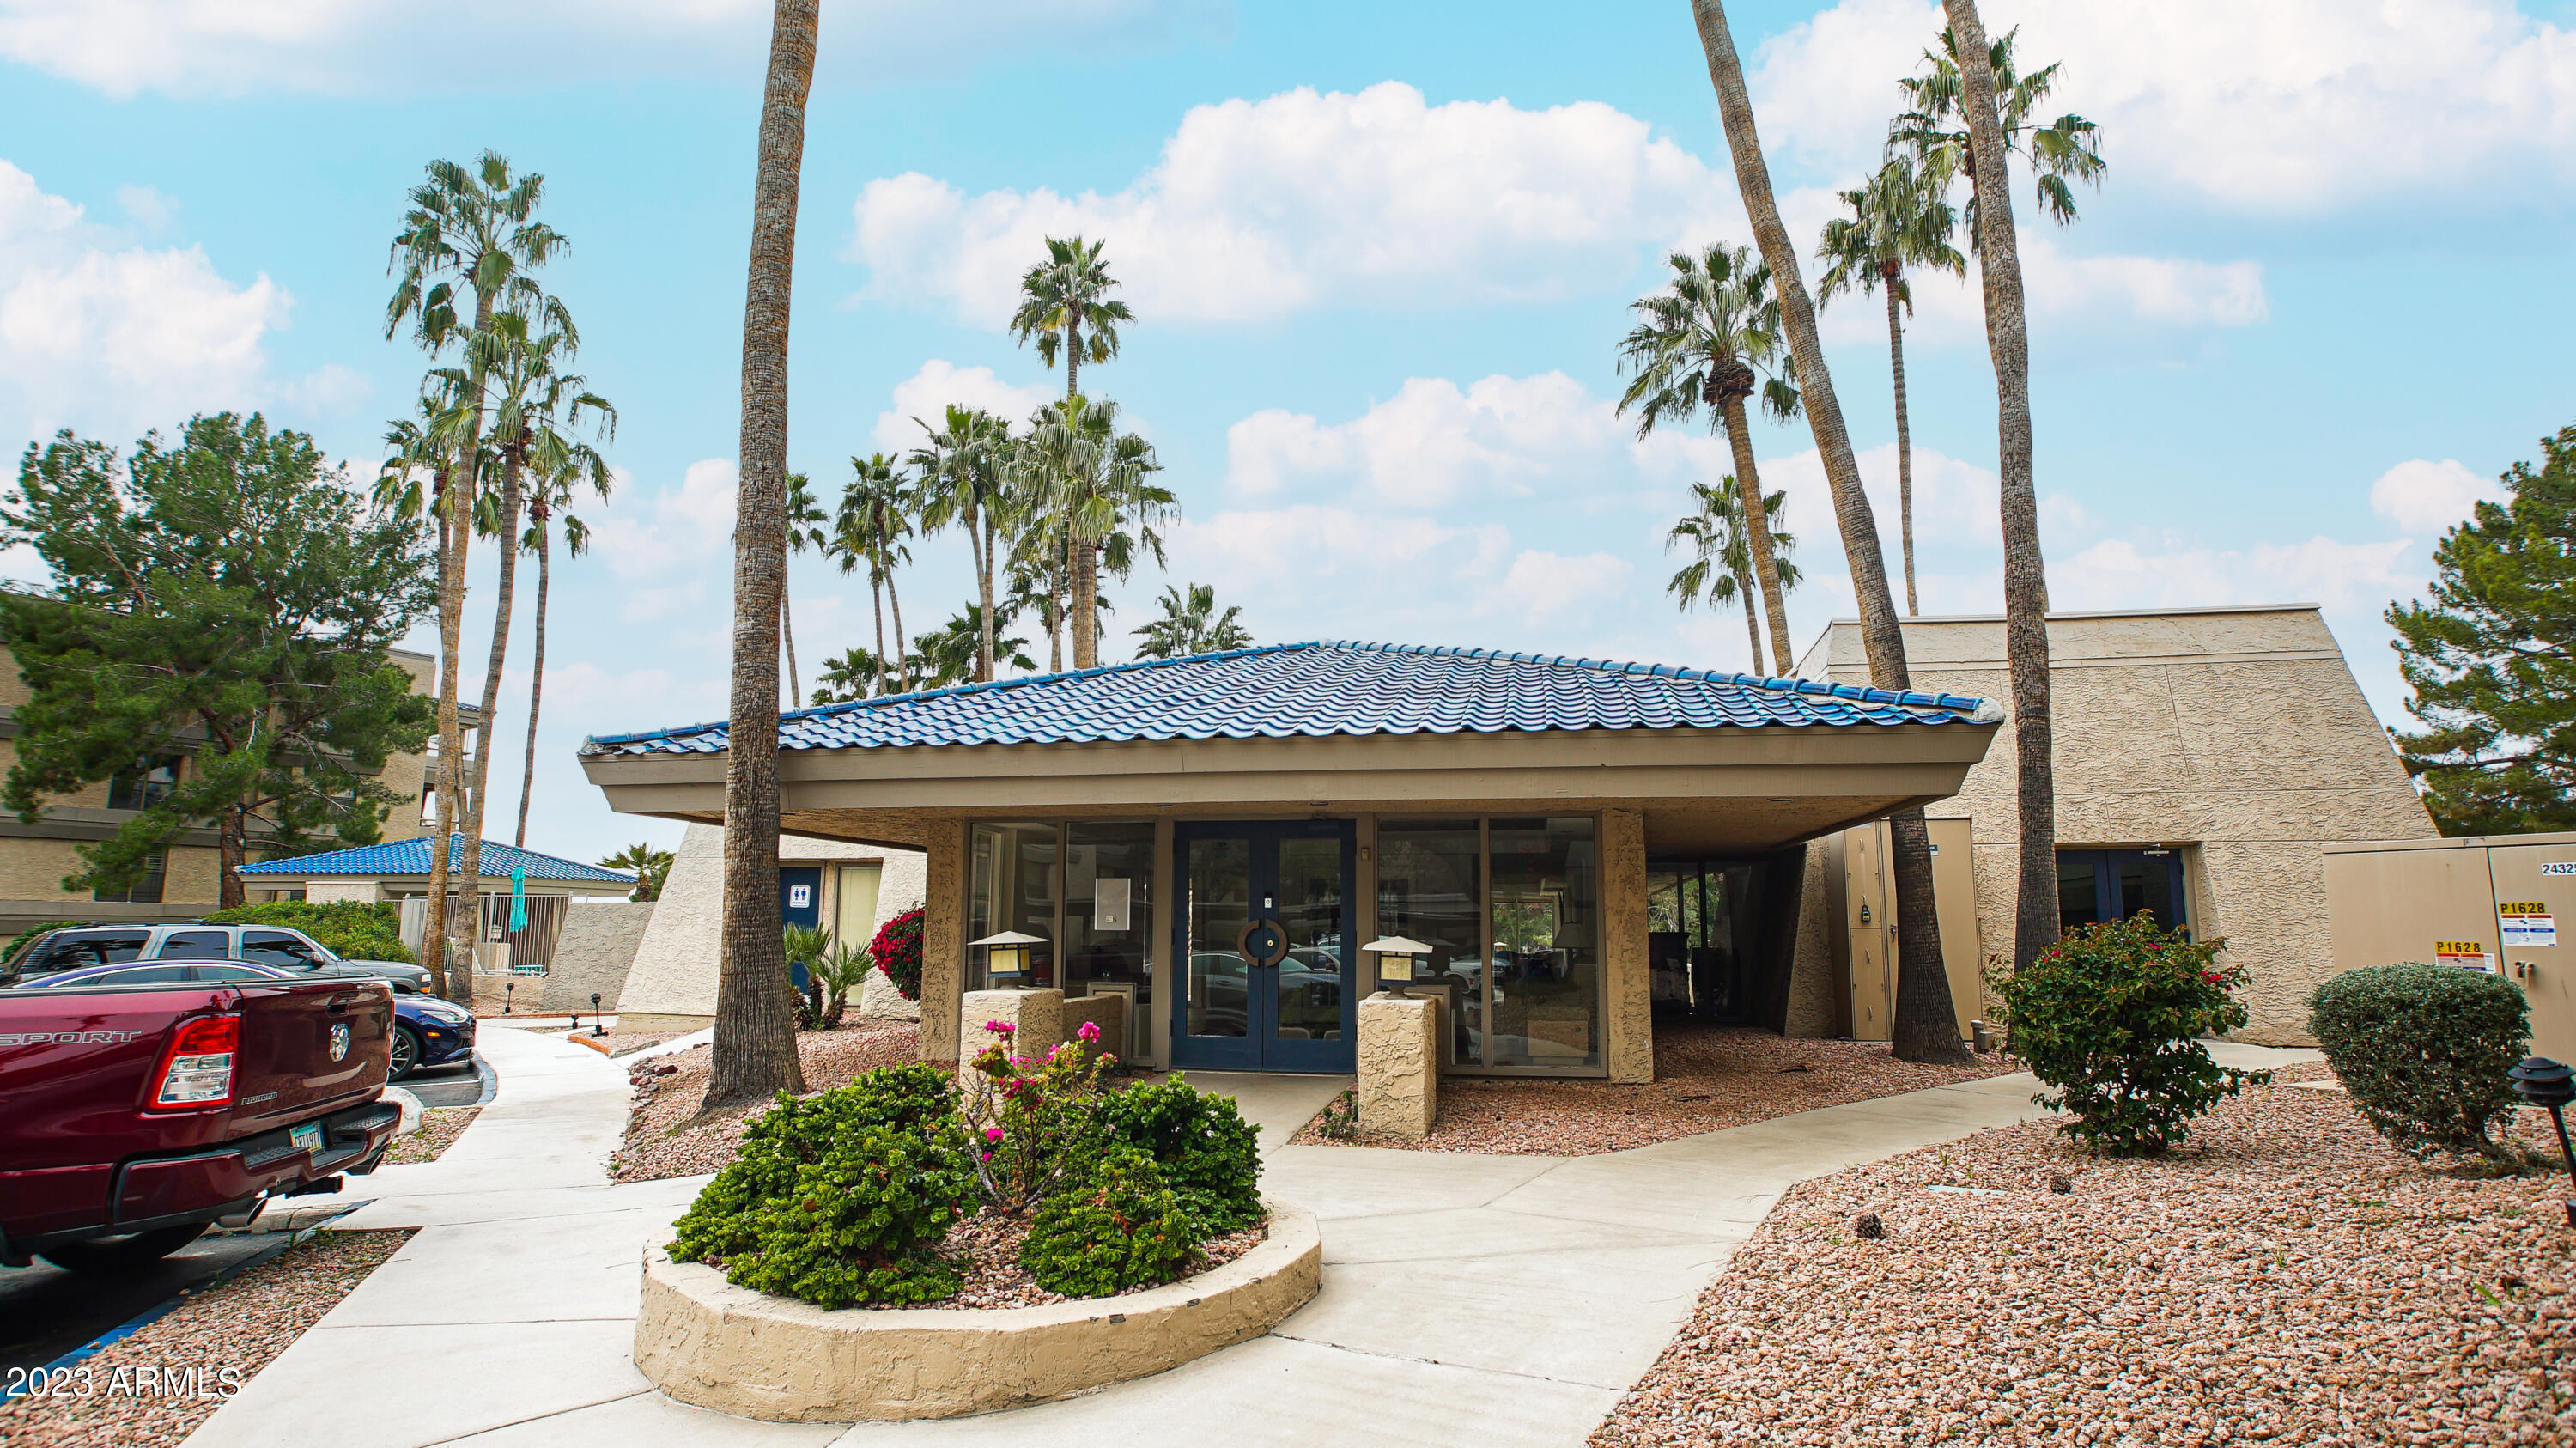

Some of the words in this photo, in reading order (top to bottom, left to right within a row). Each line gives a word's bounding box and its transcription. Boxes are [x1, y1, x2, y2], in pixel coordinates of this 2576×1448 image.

[2543, 864, 2576, 874] 2432
[2500, 903, 2545, 914] P1628
[2436, 941, 2481, 952] P1628
[0, 1031, 142, 1045] SPORT
